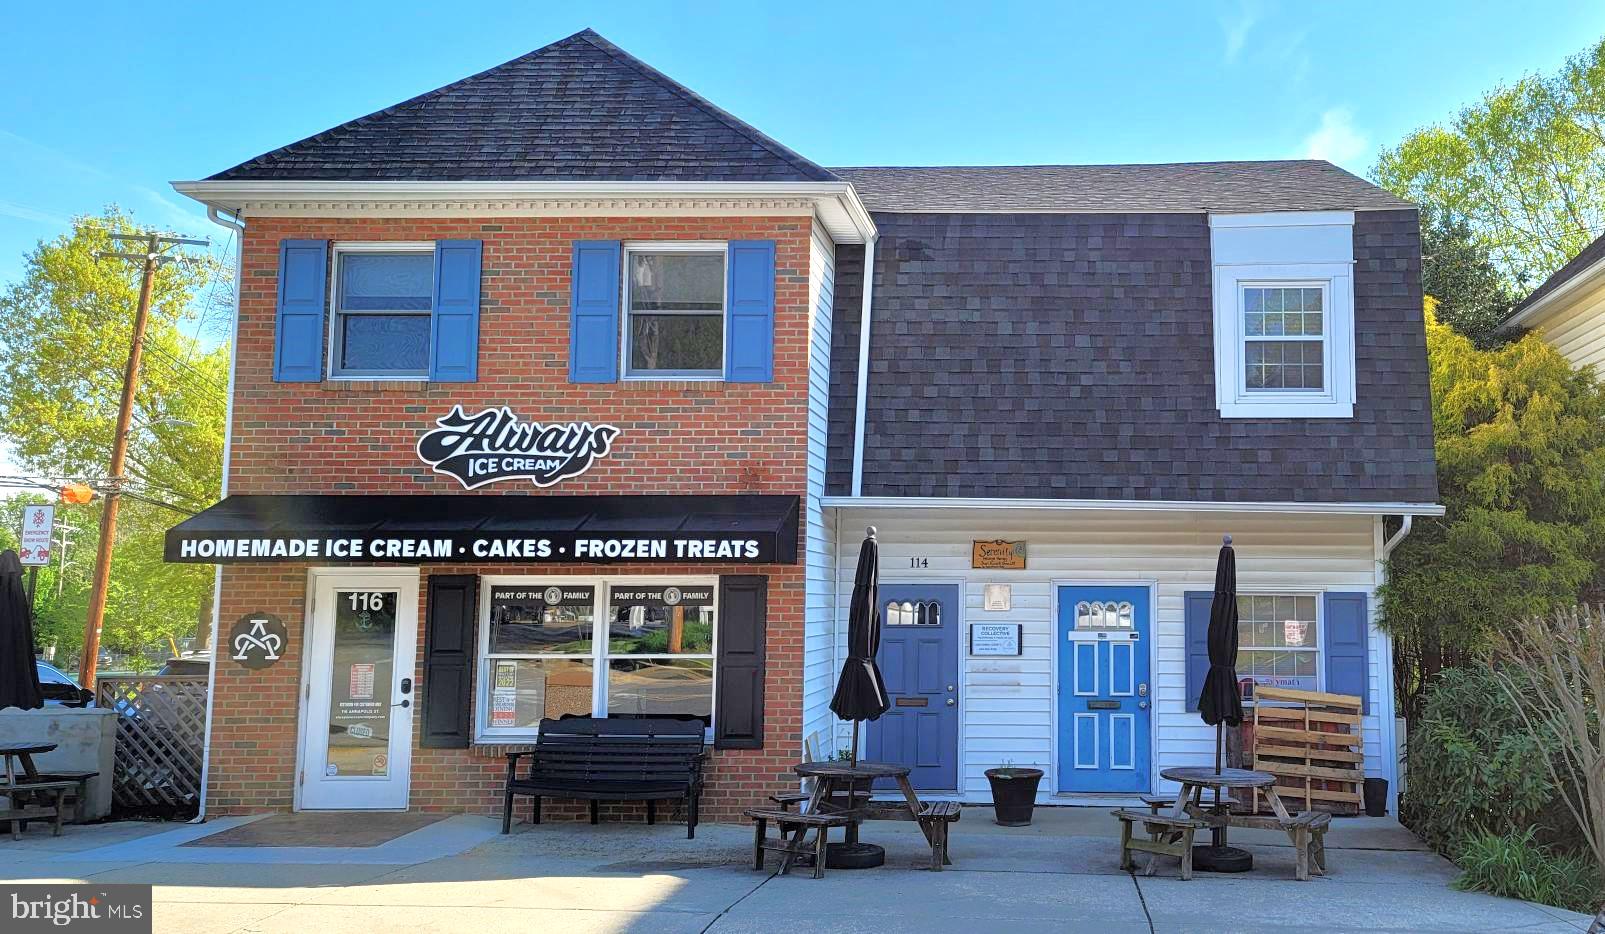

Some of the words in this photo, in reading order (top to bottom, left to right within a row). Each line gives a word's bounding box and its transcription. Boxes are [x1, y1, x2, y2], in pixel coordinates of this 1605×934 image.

[418, 406, 619, 468] Always
[468, 458, 498, 477] ICE
[501, 458, 560, 471] CREAM
[180, 539, 319, 558] HOMEMADE
[325, 539, 363, 557] ICE
[369, 539, 452, 557] CREAM
[472, 539, 552, 558] CAKES
[574, 539, 667, 558] FROZEN
[674, 539, 759, 558] TREATS
[910, 557, 928, 568] 114
[348, 592, 383, 611] 116
